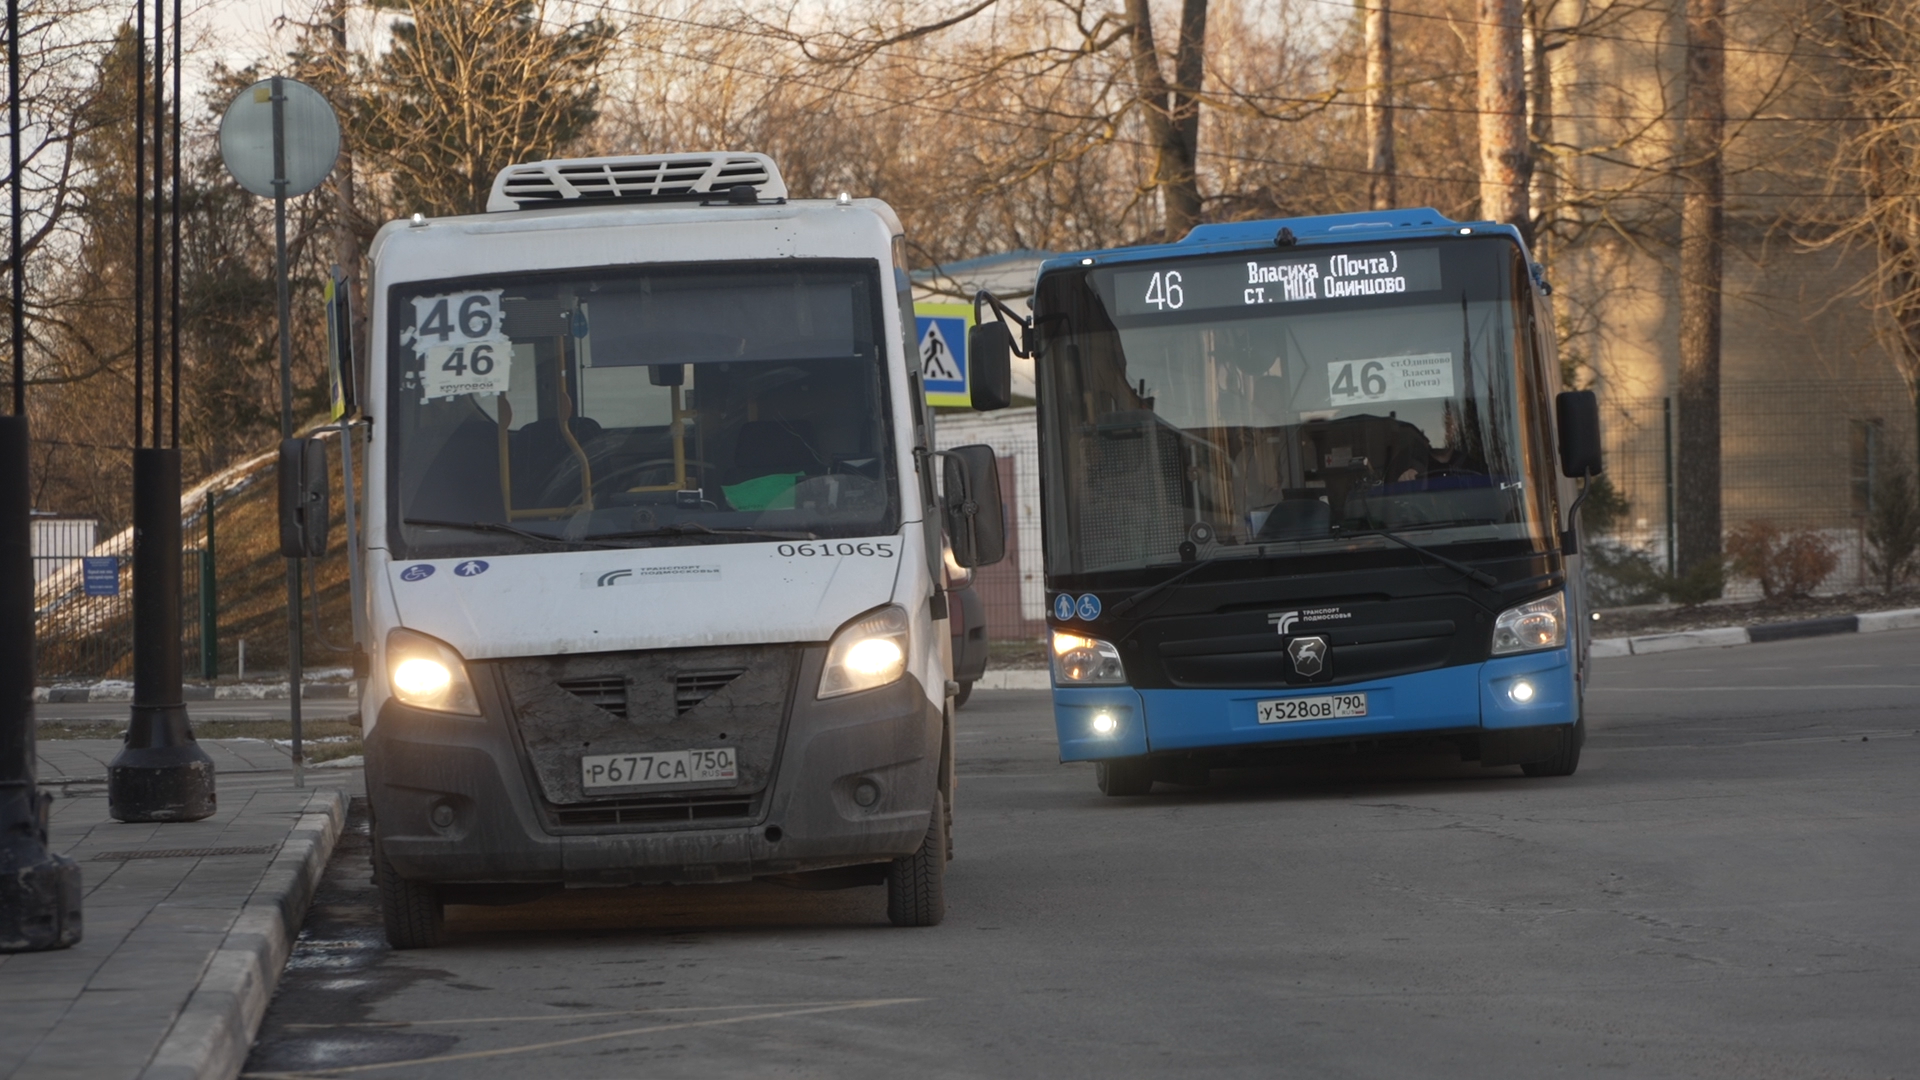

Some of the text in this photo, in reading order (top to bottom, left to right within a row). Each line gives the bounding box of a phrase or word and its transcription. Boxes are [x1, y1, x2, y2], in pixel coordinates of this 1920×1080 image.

[1247, 251, 1397, 284] Власиха (Почта)
[1145, 271, 1183, 310] 46
[1244, 276, 1405, 304] ст. МЦД Одинцово
[419, 295, 492, 341] 46
[442, 344, 494, 376] 46
[1331, 361, 1387, 399] 46
[1402, 369, 1441, 378] Власиха
[1403, 378, 1441, 390] (Почта)
[777, 543, 893, 558] 061065
[1303, 607, 1340, 615] ТРАНСПОРТ
[1303, 613, 1351, 622] ПОДМОСКОВЬЯ
[1334, 696, 1361, 710] 790
[692, 751, 728, 770] 750
[702, 769, 720, 777] RUS
